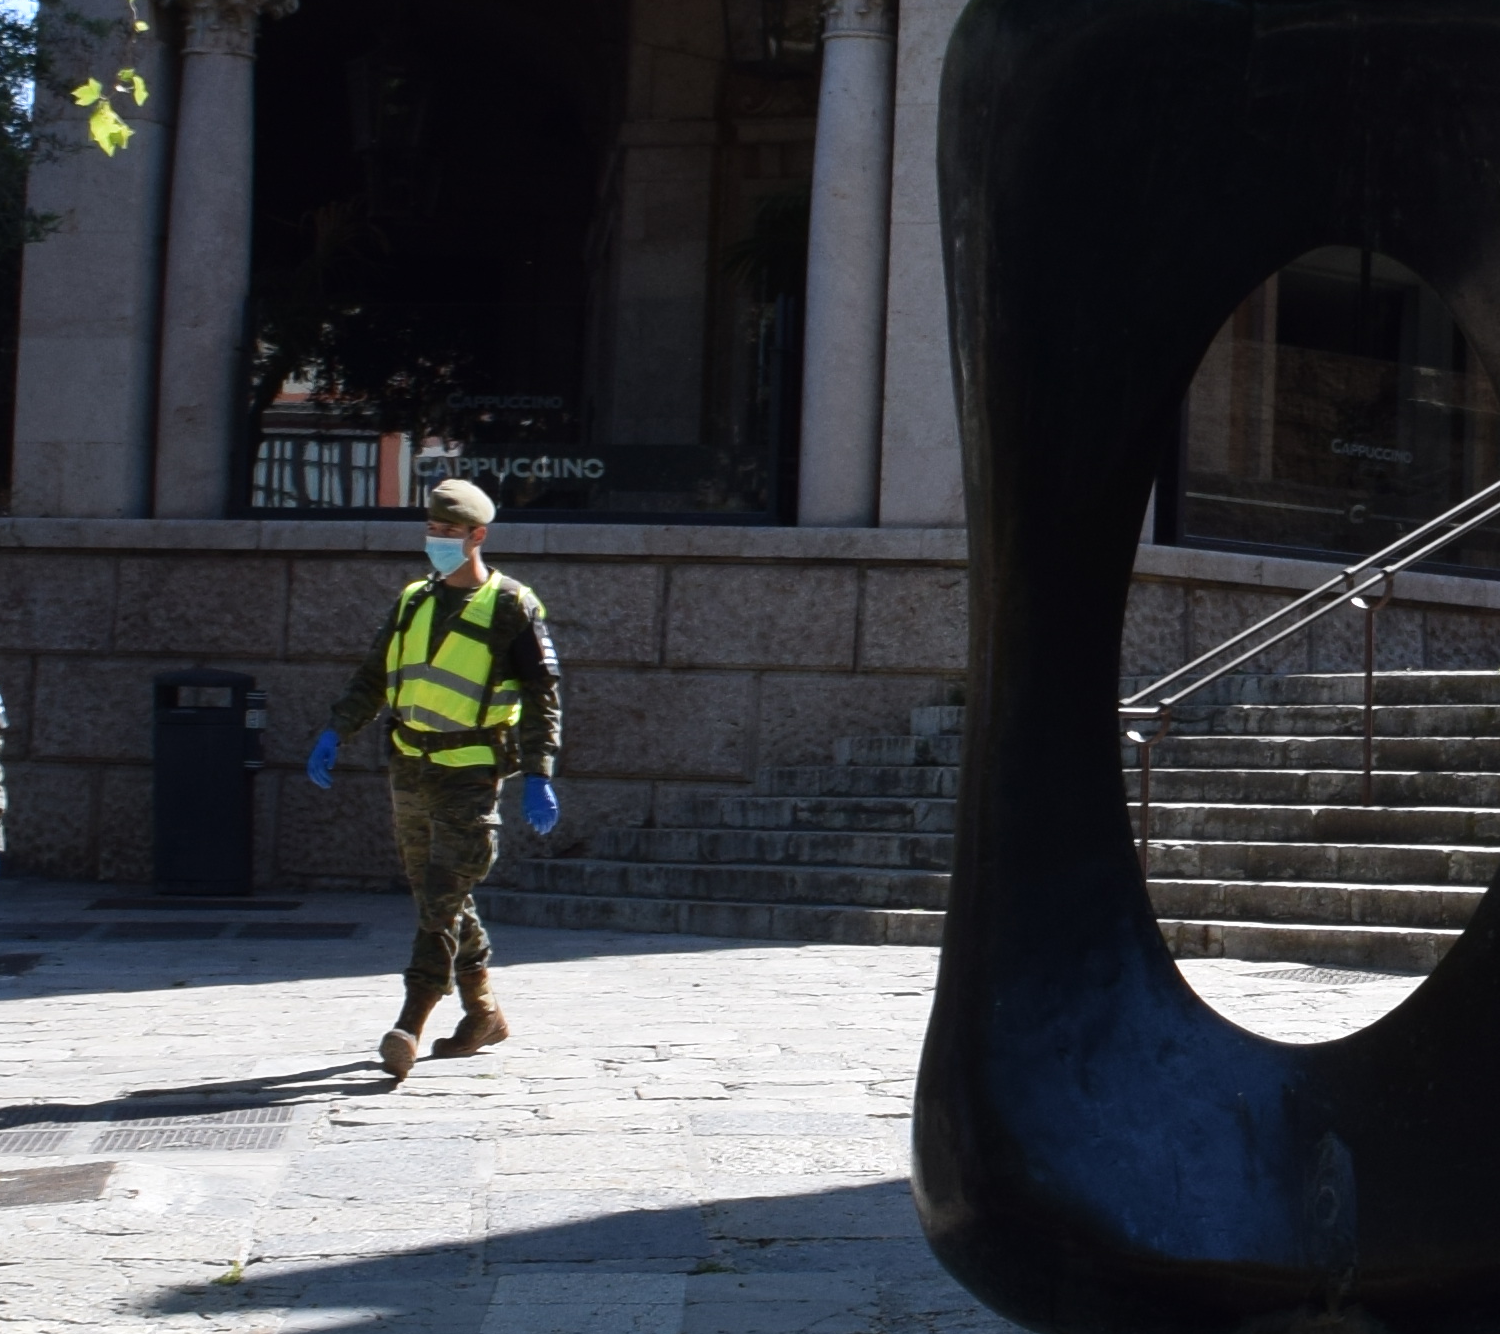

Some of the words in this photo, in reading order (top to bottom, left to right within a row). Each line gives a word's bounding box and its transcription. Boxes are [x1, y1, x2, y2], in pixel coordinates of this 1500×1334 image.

[445, 393, 563, 410] CAPPUCCINO
[1330, 438, 1414, 464] CAPPUCCINO
[413, 456, 606, 479] CAPPUCCINO
